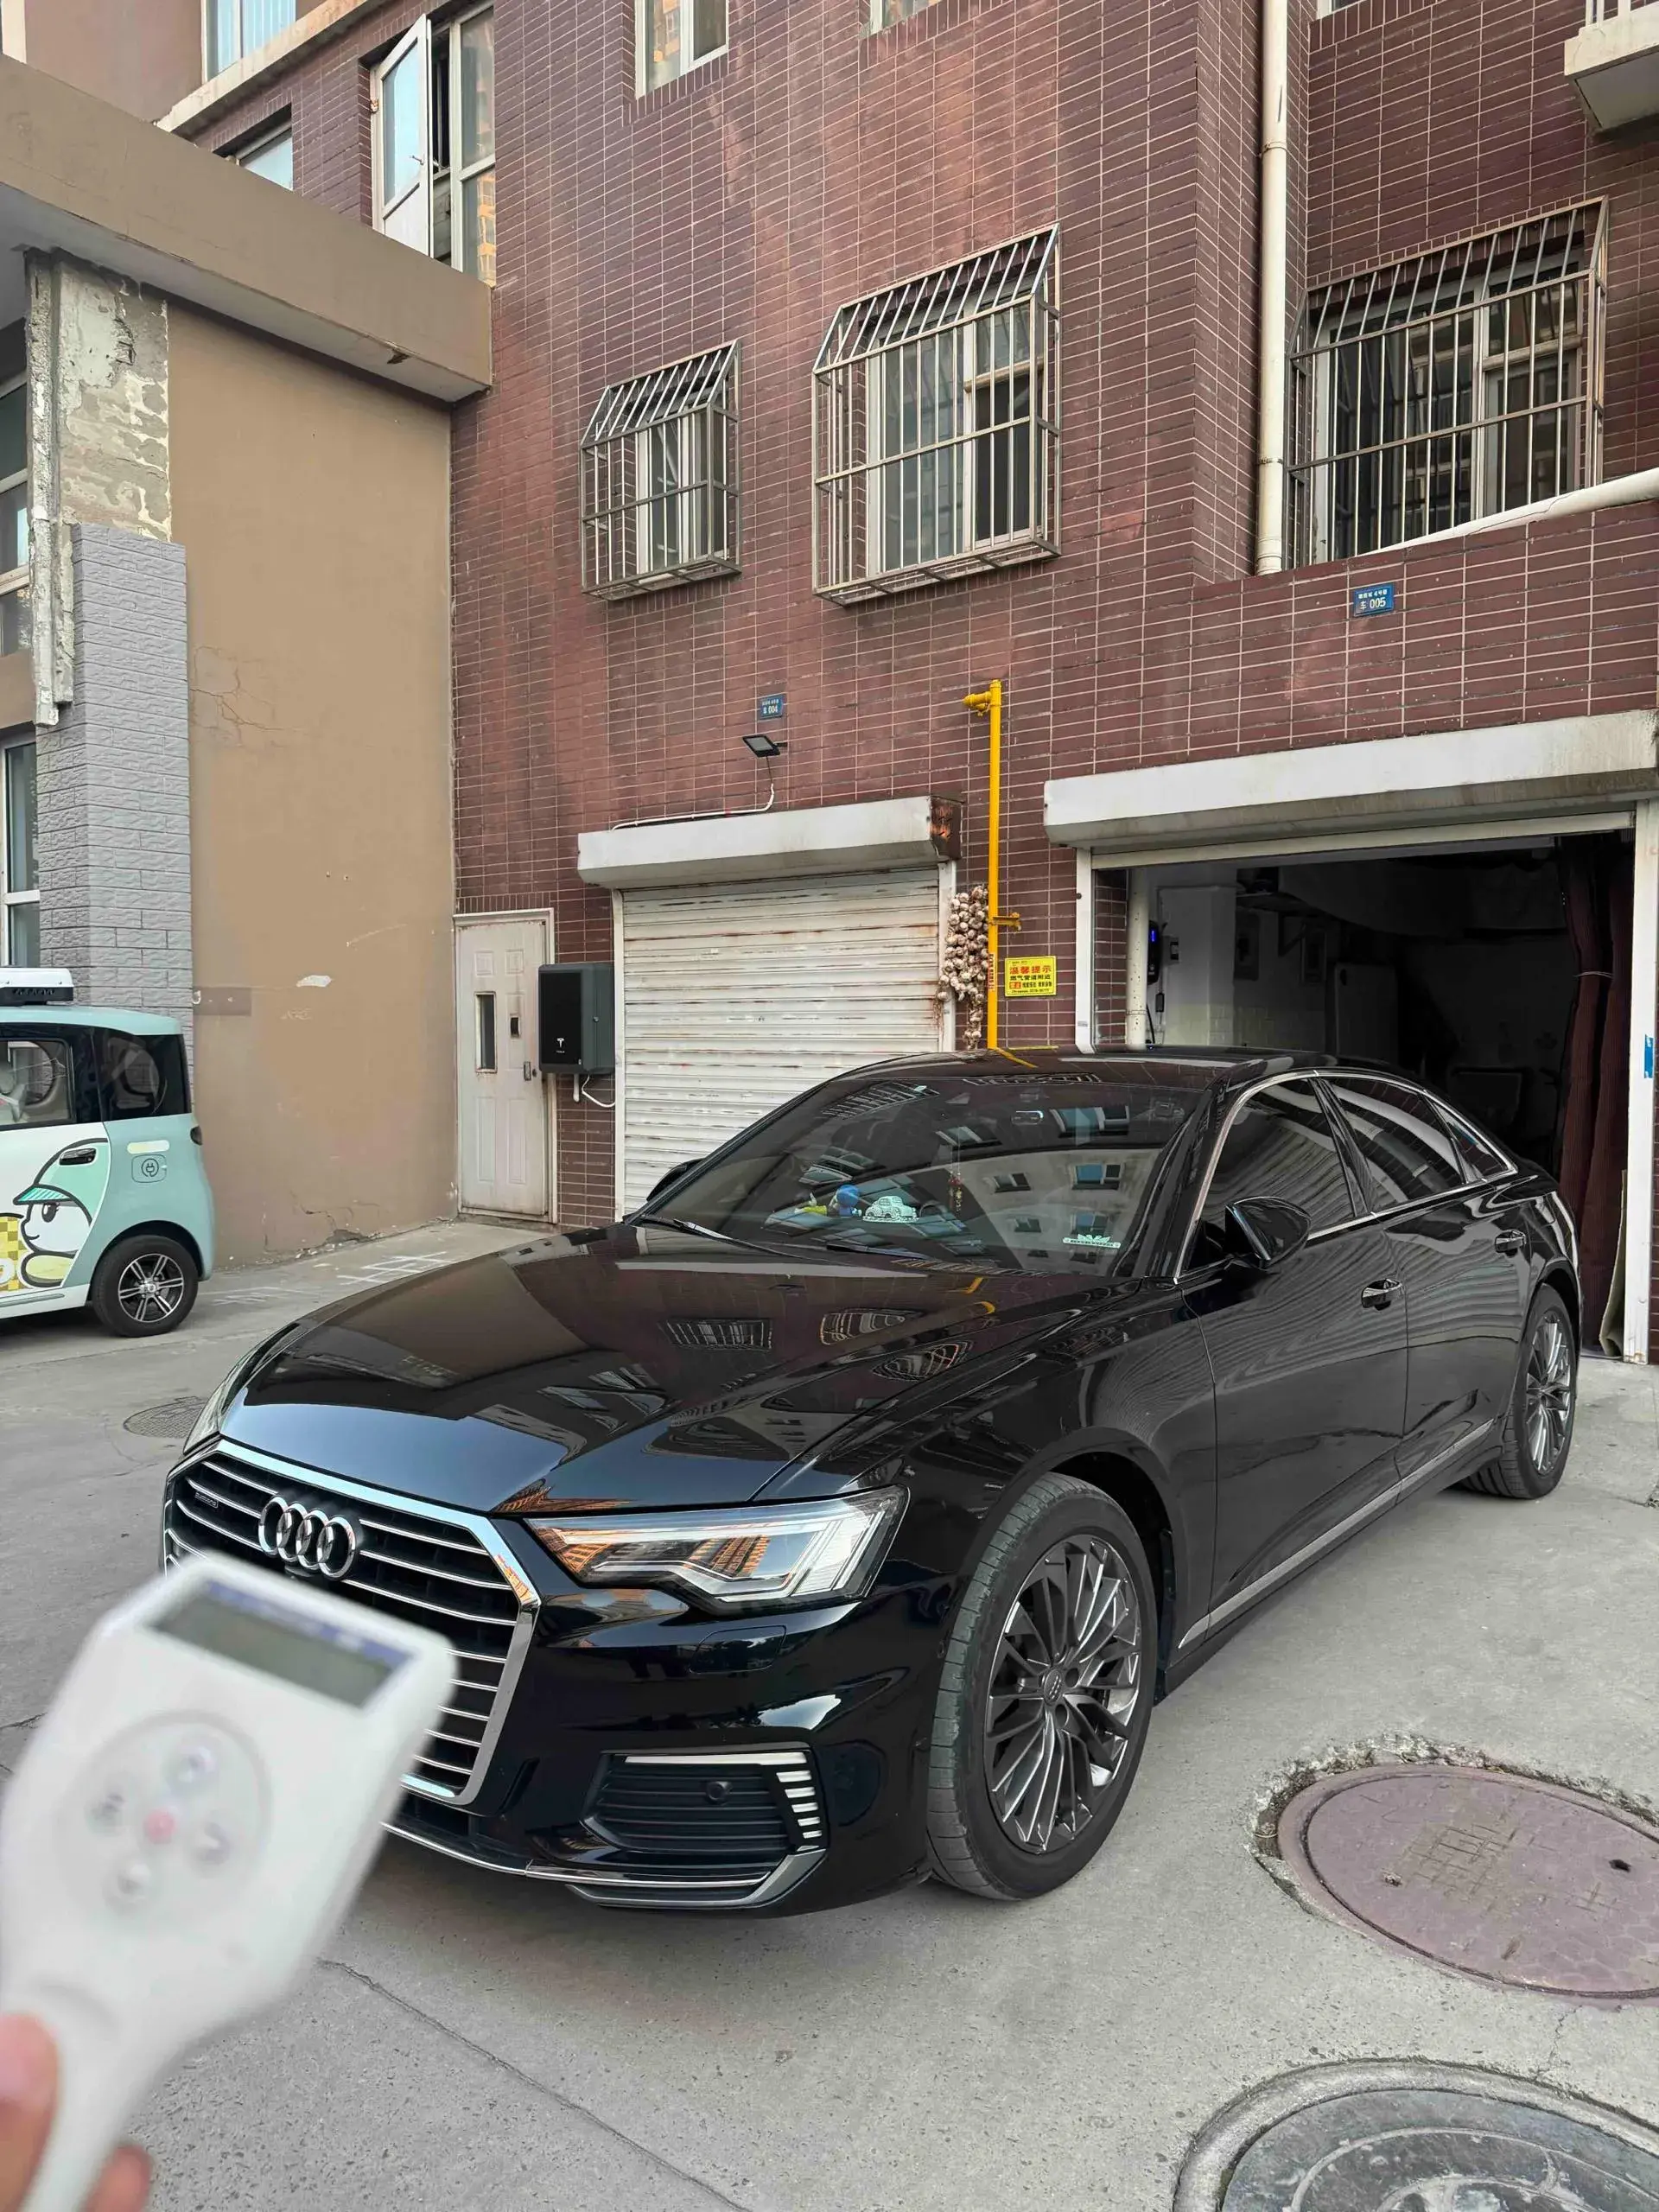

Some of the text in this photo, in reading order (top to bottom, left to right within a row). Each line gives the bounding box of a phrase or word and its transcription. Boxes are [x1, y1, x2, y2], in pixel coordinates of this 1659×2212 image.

[1370, 597, 1386, 608] 005
[1010, 965, 1051, 974] 温馨提示
